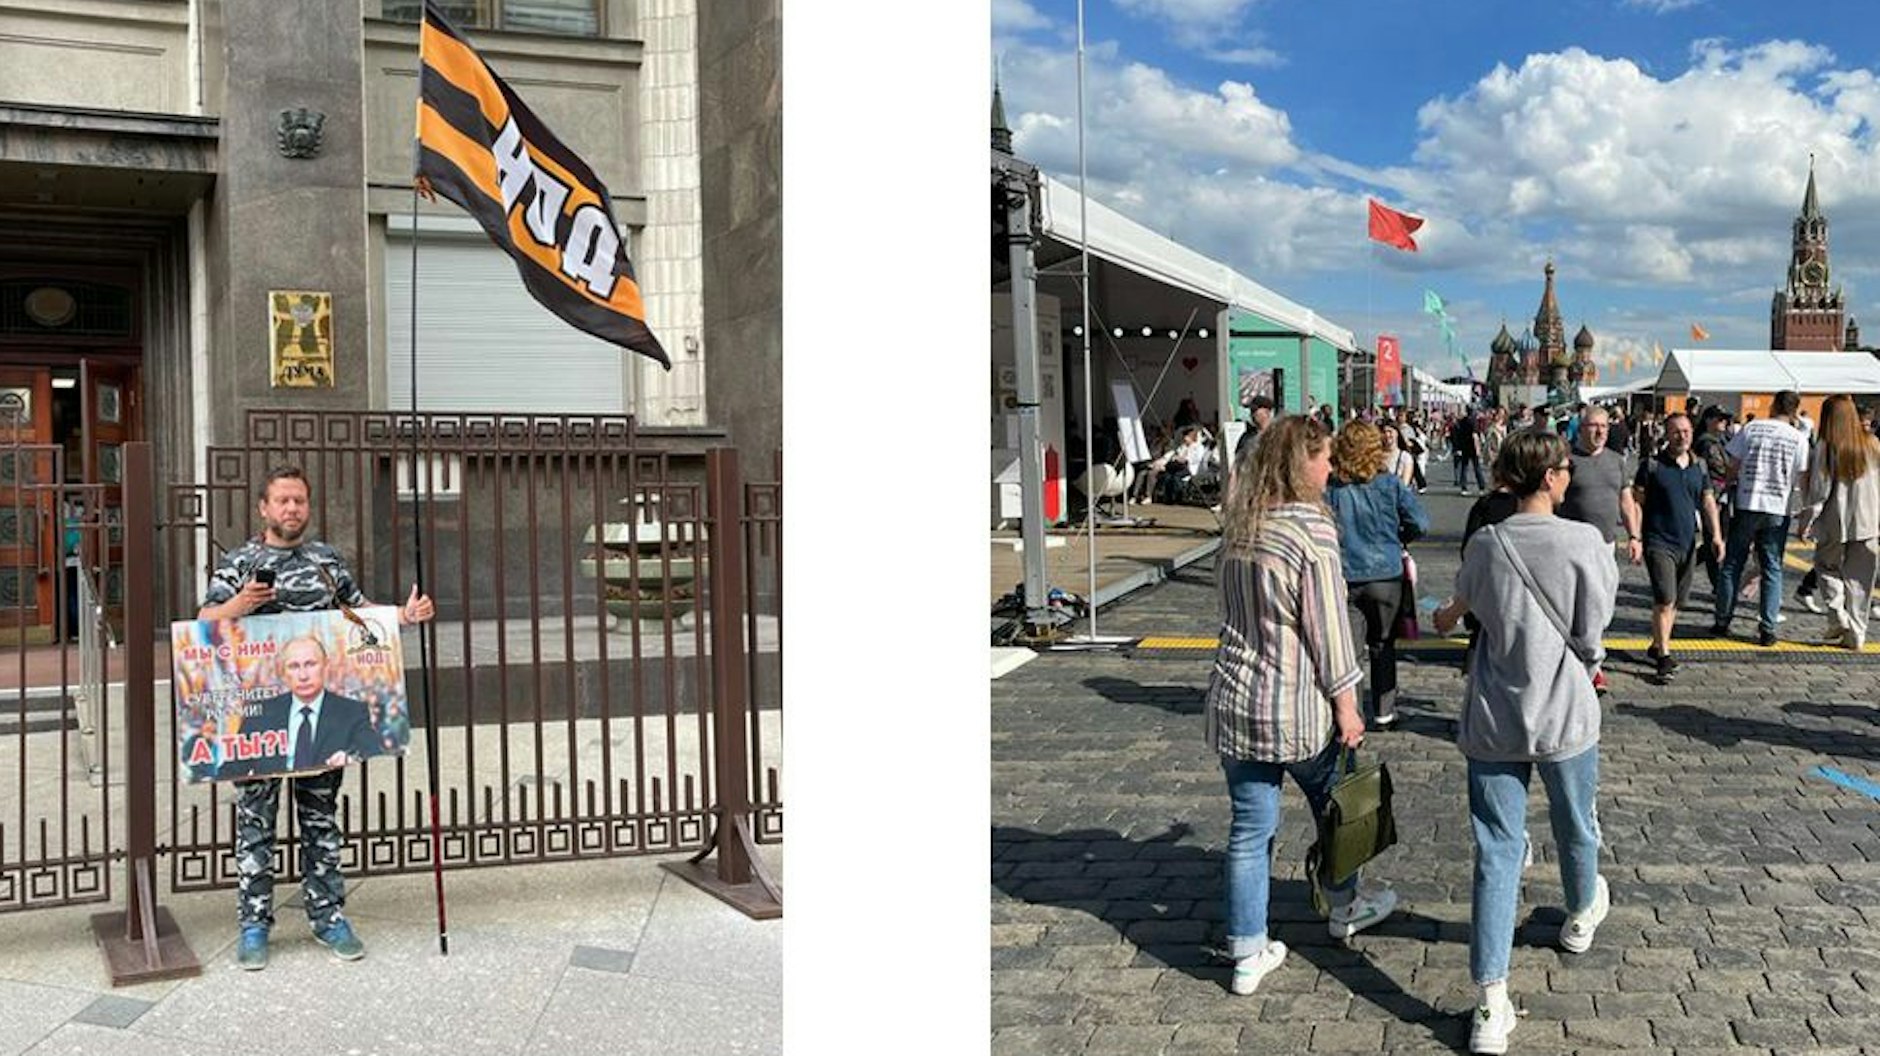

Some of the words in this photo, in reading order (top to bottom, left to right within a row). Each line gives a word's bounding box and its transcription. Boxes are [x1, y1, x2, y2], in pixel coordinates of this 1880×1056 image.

[1383, 340, 1393, 361] 2
[184, 647, 213, 661] МЫ
[218, 645, 231, 659] С
[238, 641, 277, 657] НИМ
[192, 740, 213, 763] А
[221, 731, 288, 760] ТЫ?!
